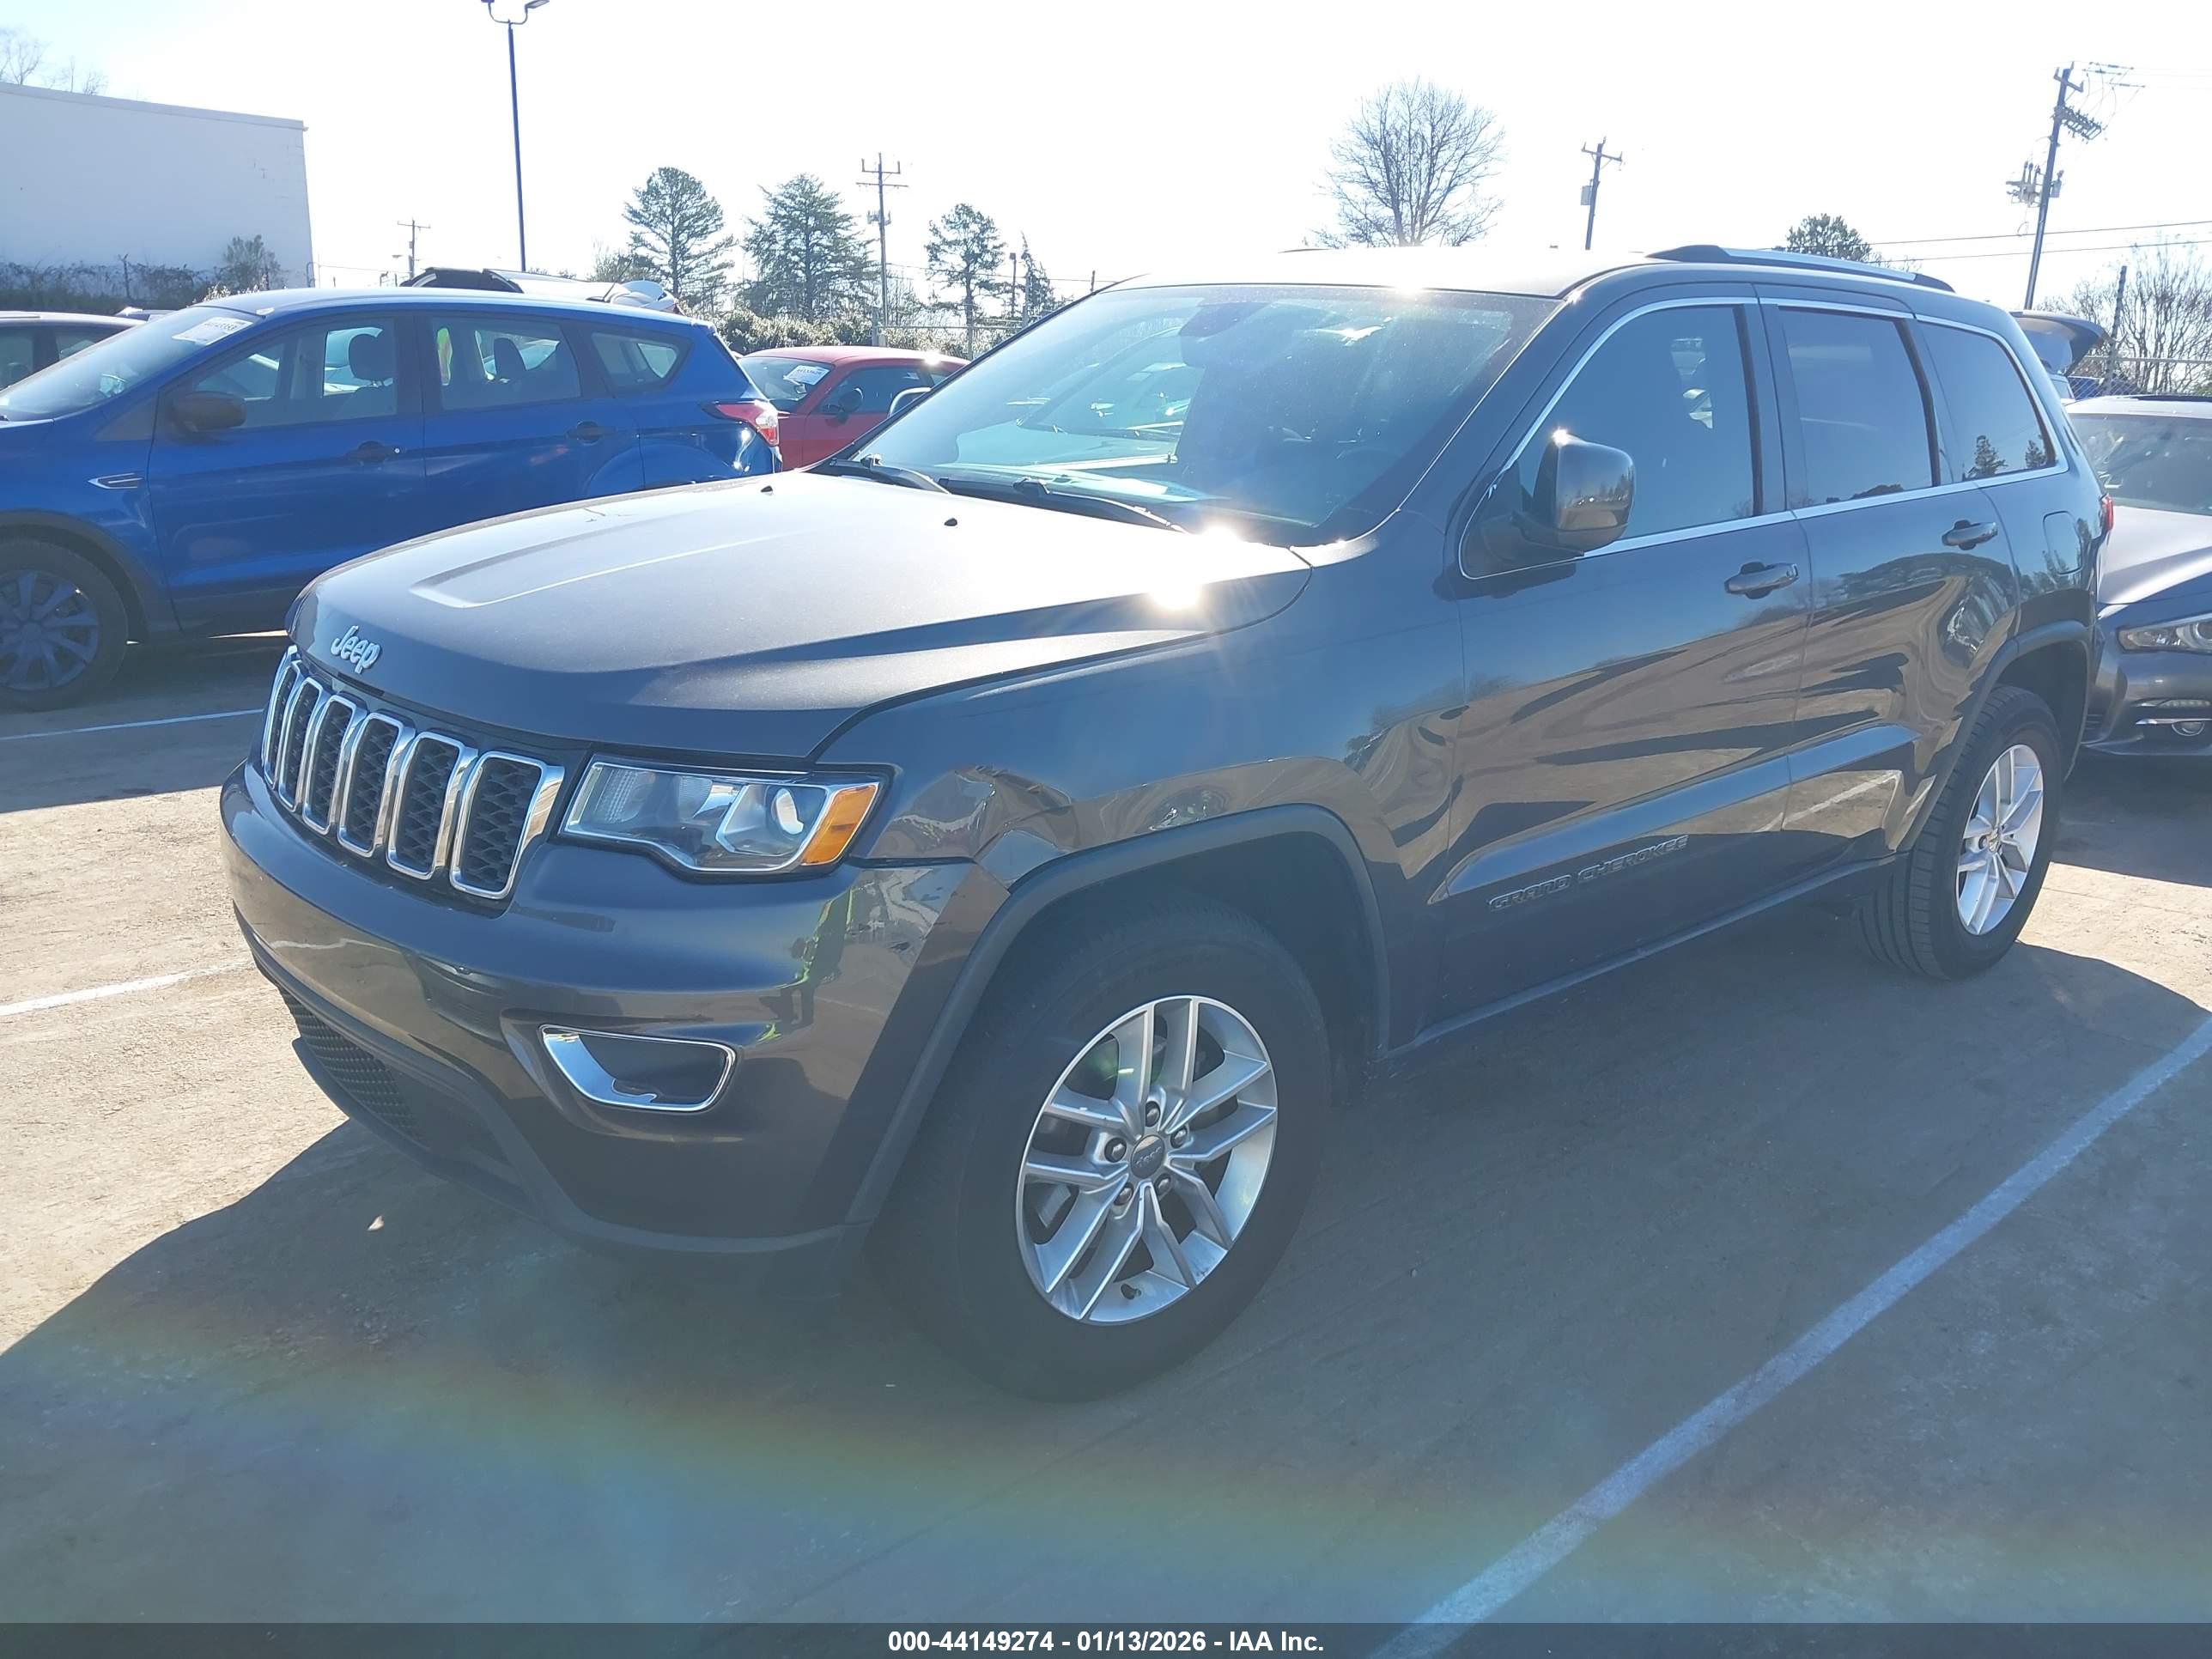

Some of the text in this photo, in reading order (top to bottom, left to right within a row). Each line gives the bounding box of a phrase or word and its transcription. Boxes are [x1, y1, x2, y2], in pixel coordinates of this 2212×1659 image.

[330, 624, 381, 675] Jeep
[1488, 834, 1690, 911] GRAND CHEROKEE
